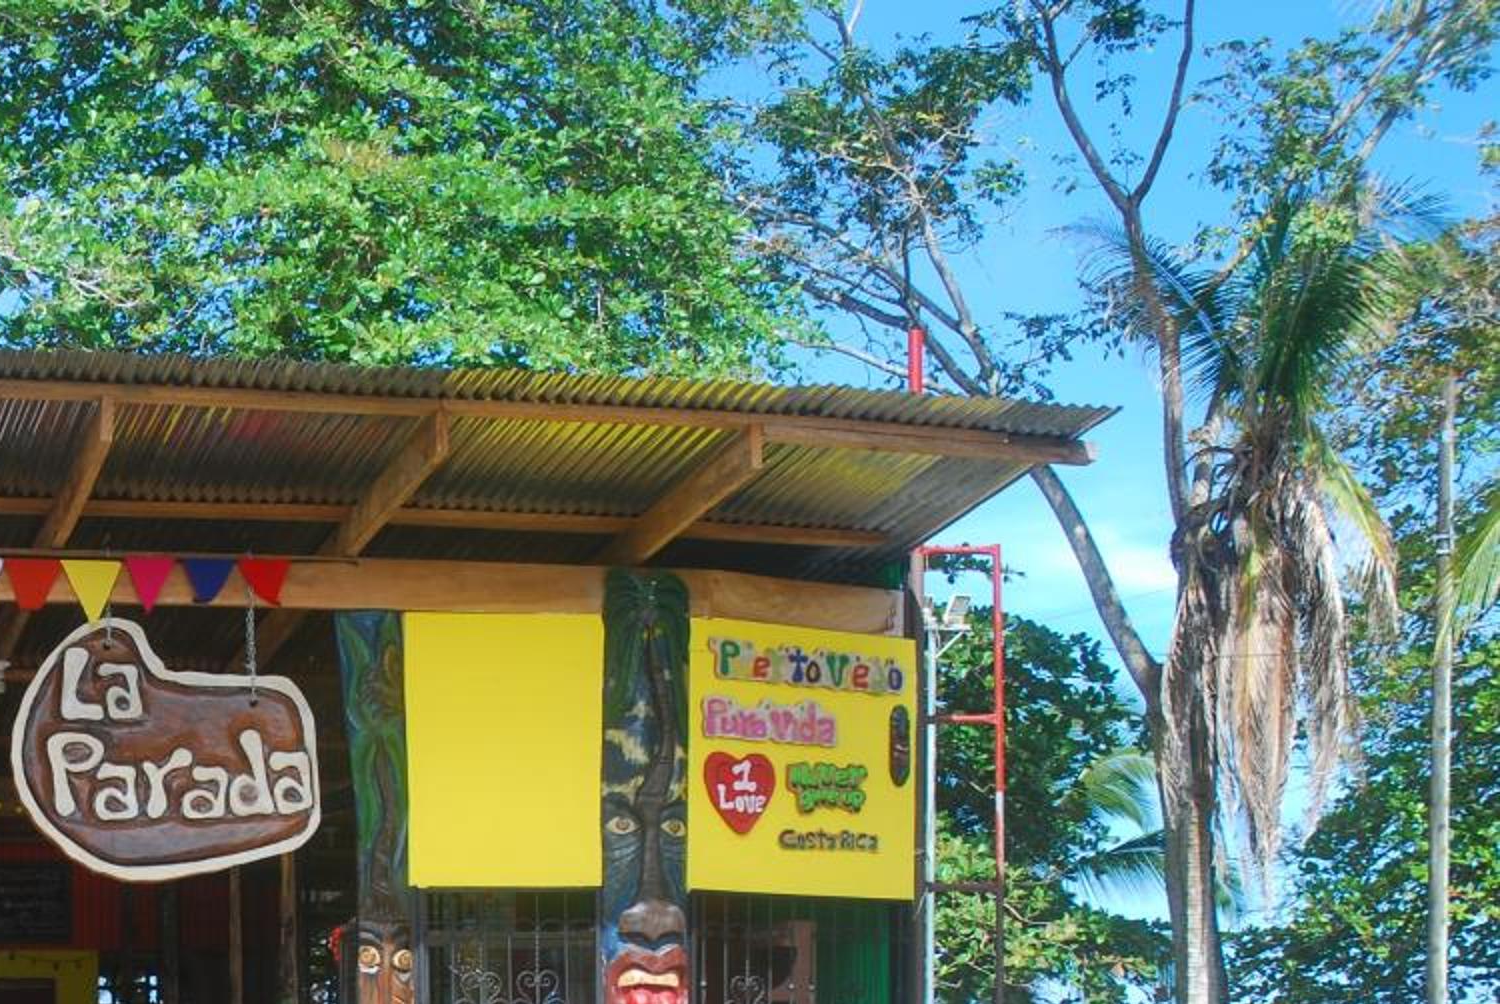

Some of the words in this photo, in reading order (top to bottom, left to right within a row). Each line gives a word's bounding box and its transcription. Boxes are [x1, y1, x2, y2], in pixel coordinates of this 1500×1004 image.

[61, 647, 143, 721] La
[47, 729, 313, 821] Parada
[731, 759, 757, 792] 1
